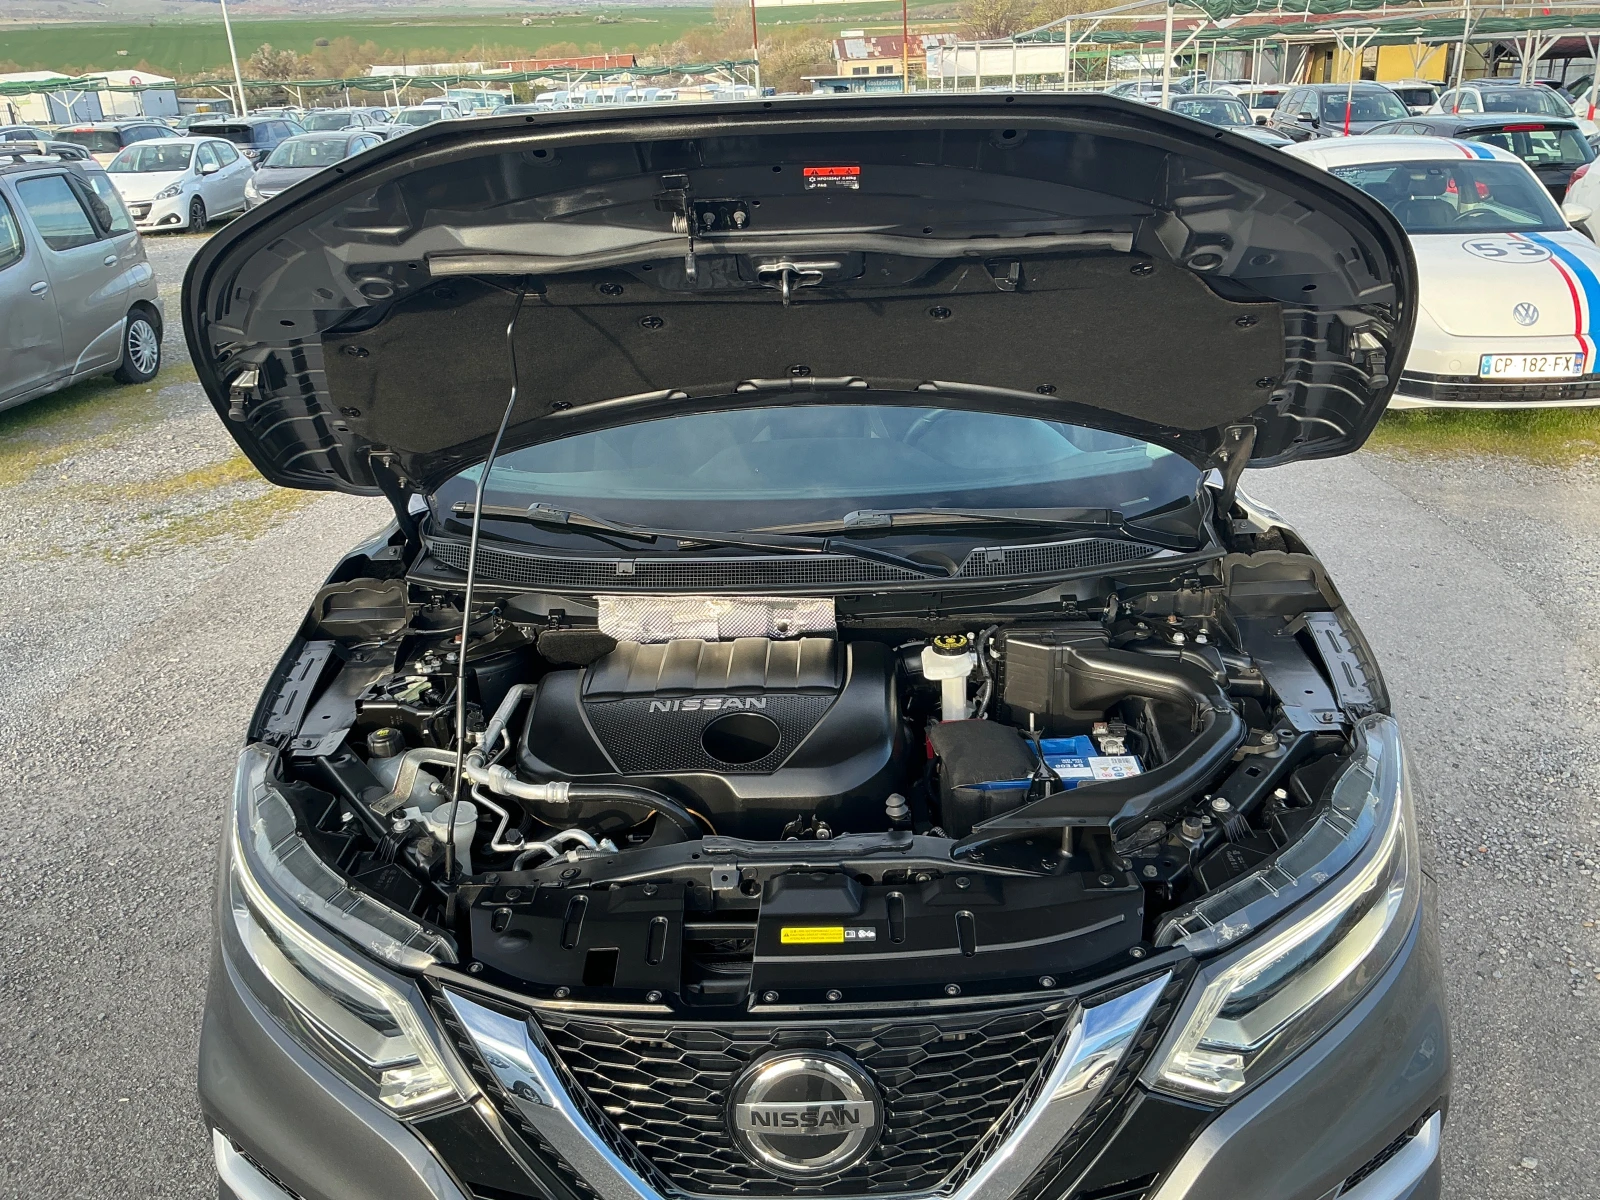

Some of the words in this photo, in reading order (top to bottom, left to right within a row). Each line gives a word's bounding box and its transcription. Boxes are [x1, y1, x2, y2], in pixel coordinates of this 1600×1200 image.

[1470, 242, 1546, 257] 53
[649, 697, 767, 712] NISSAN
[750, 1108, 860, 1127] NISSAN
